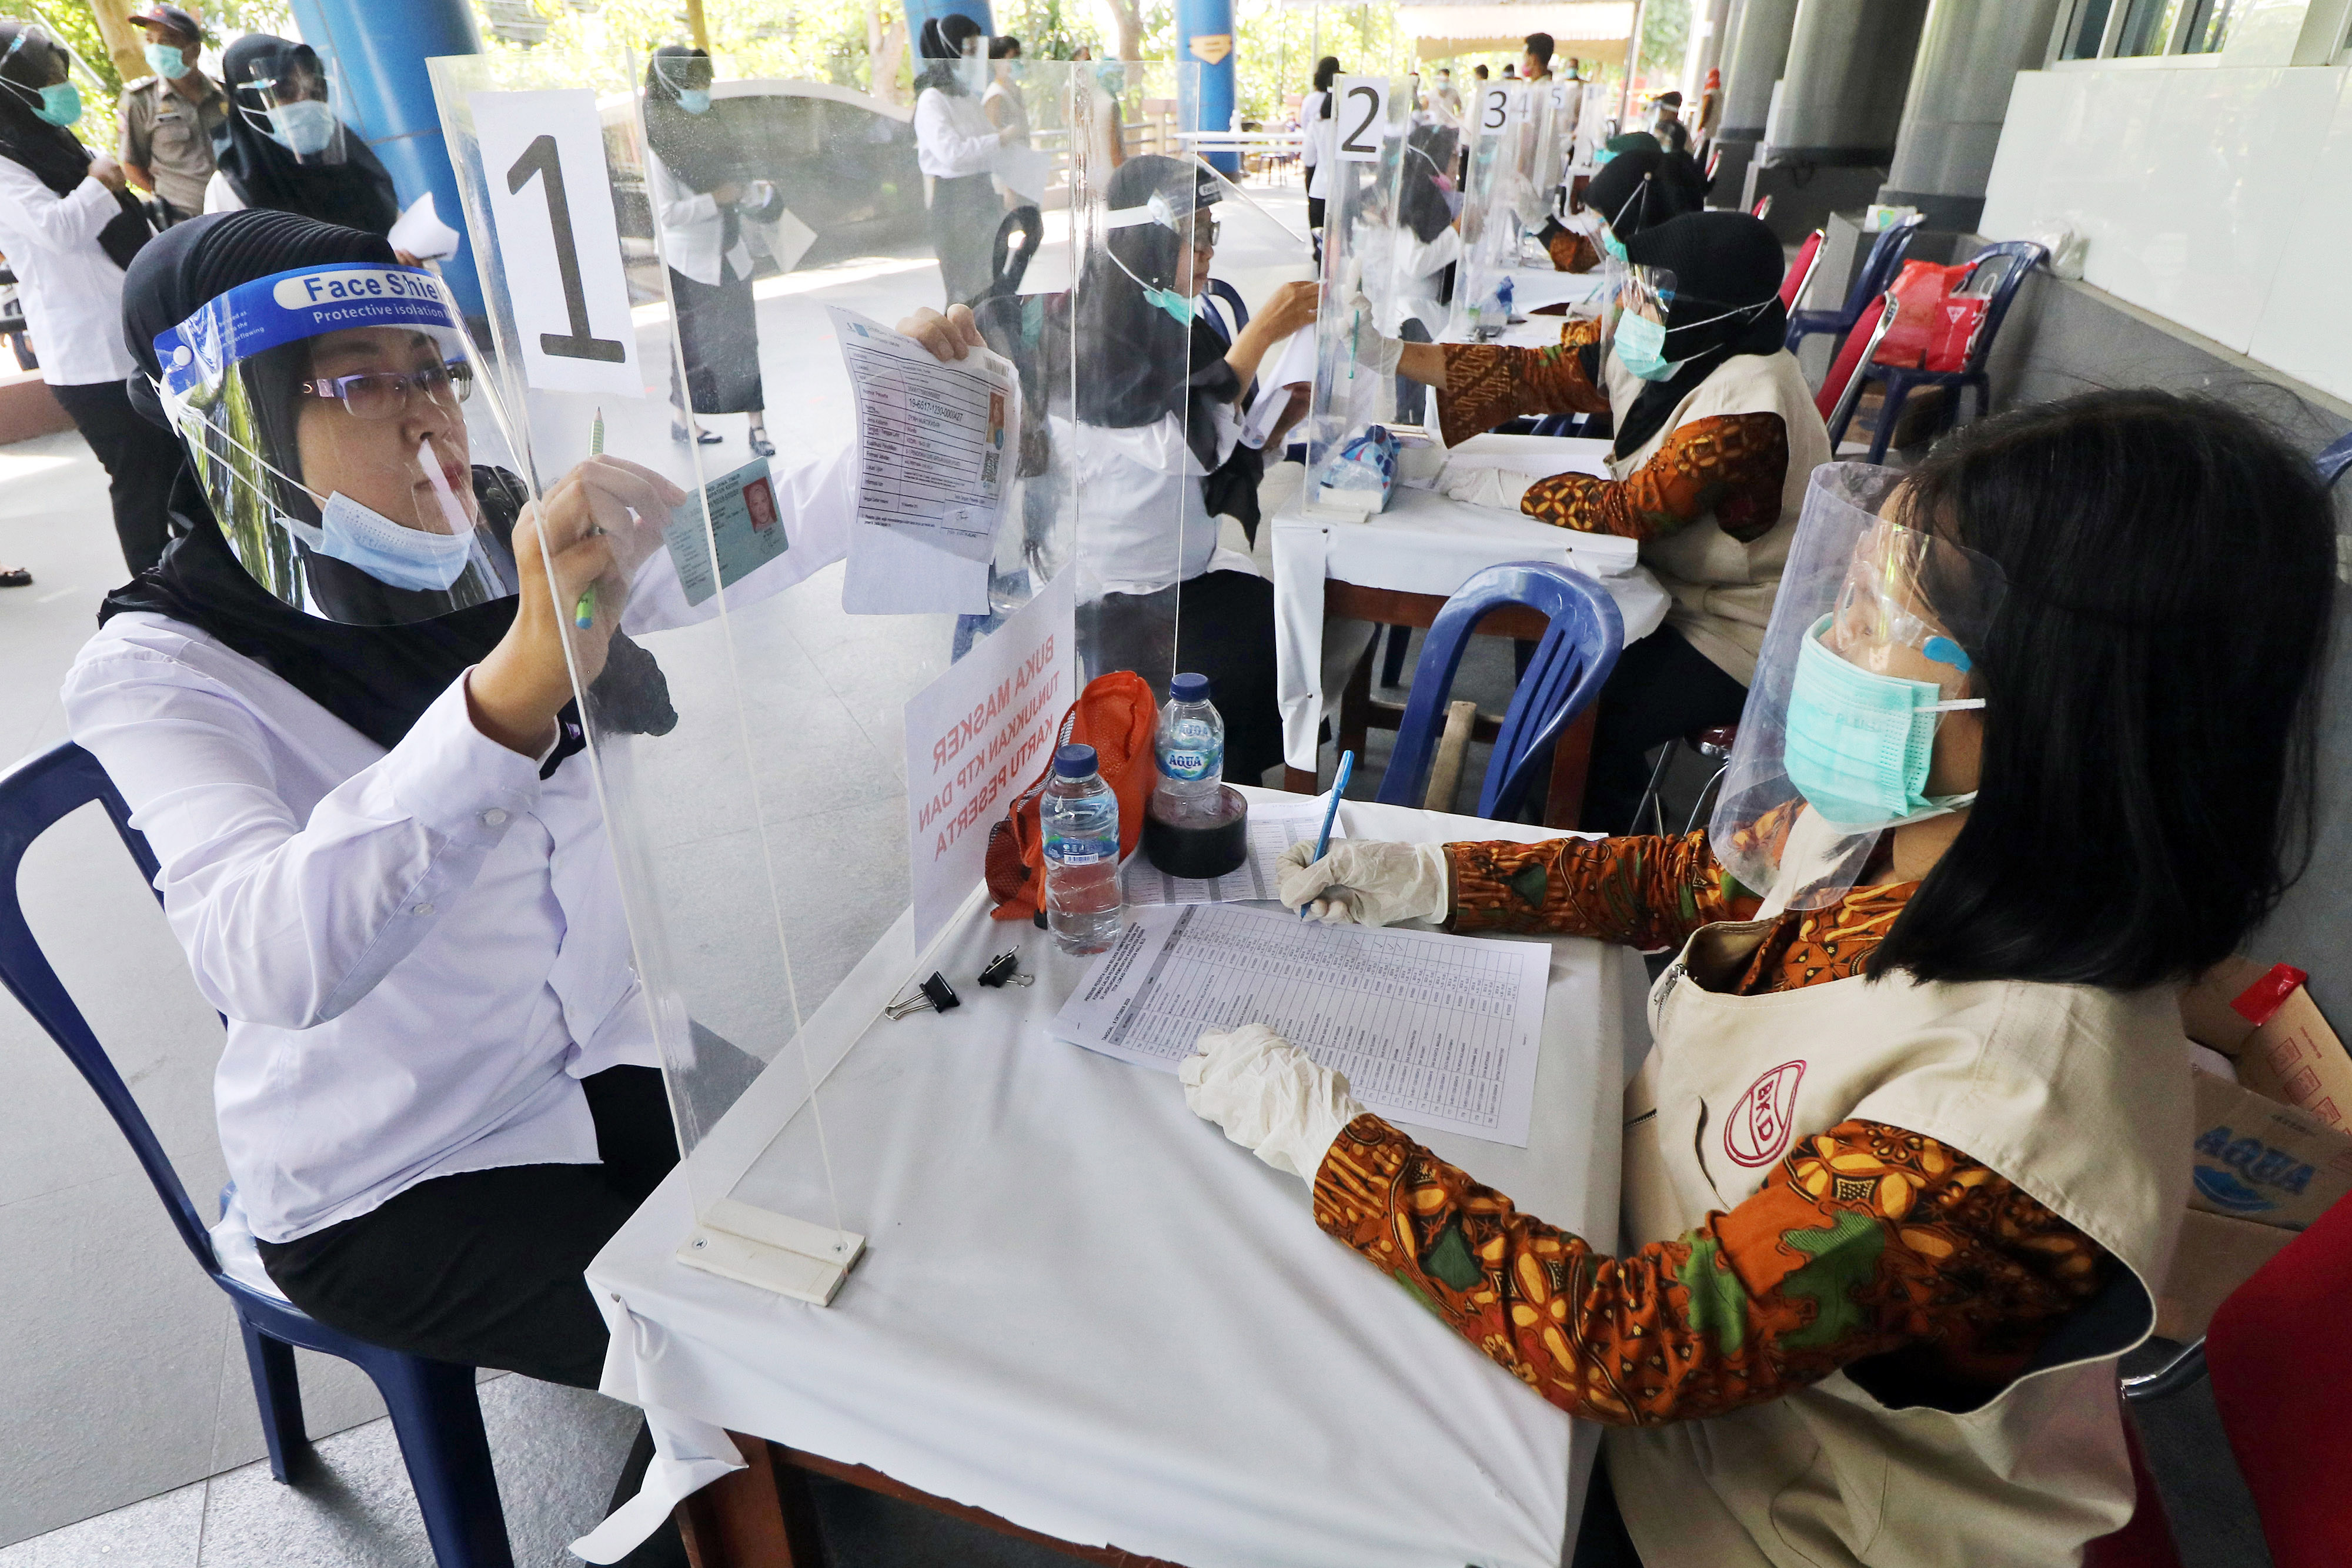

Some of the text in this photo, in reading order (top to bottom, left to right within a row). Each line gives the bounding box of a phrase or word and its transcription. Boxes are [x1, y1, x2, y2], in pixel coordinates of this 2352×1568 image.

[1485, 91, 1506, 129] 3
[1511, 93, 1528, 119] 4
[1552, 88, 1561, 105] 5
[1341, 86, 1381, 153] 2
[507, 135, 624, 362] 1
[304, 273, 443, 302] Face Shiel
[313, 303, 392, 324] Protective
[393, 303, 444, 318] isolation
[228, 326, 265, 346] overflowing
[1169, 755, 1202, 768] AQUA
[1756, 1079, 1774, 1142] BKD
[2194, 1125, 2316, 1195] AQUA
